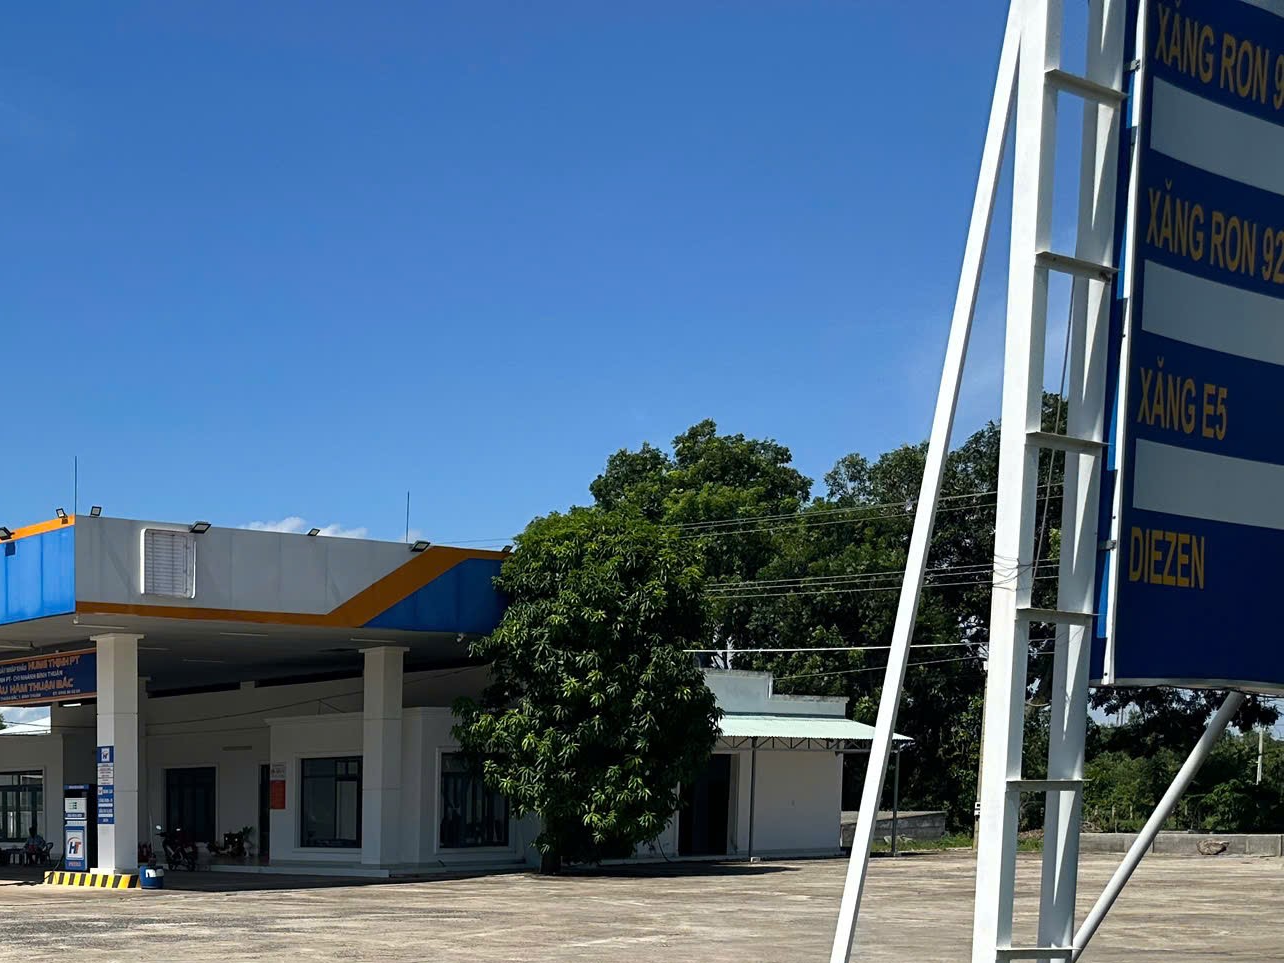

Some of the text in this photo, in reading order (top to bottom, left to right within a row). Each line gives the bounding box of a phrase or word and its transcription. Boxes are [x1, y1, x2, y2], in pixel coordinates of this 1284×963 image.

[1155, 0, 1214, 84] XĂNG
[1220, 33, 1269, 104] RON
[1146, 178, 1284, 284] XĂNG RON 92
[1137, 356, 1228, 441] XĂNG E5
[1129, 526, 1205, 590] DIEZEN
